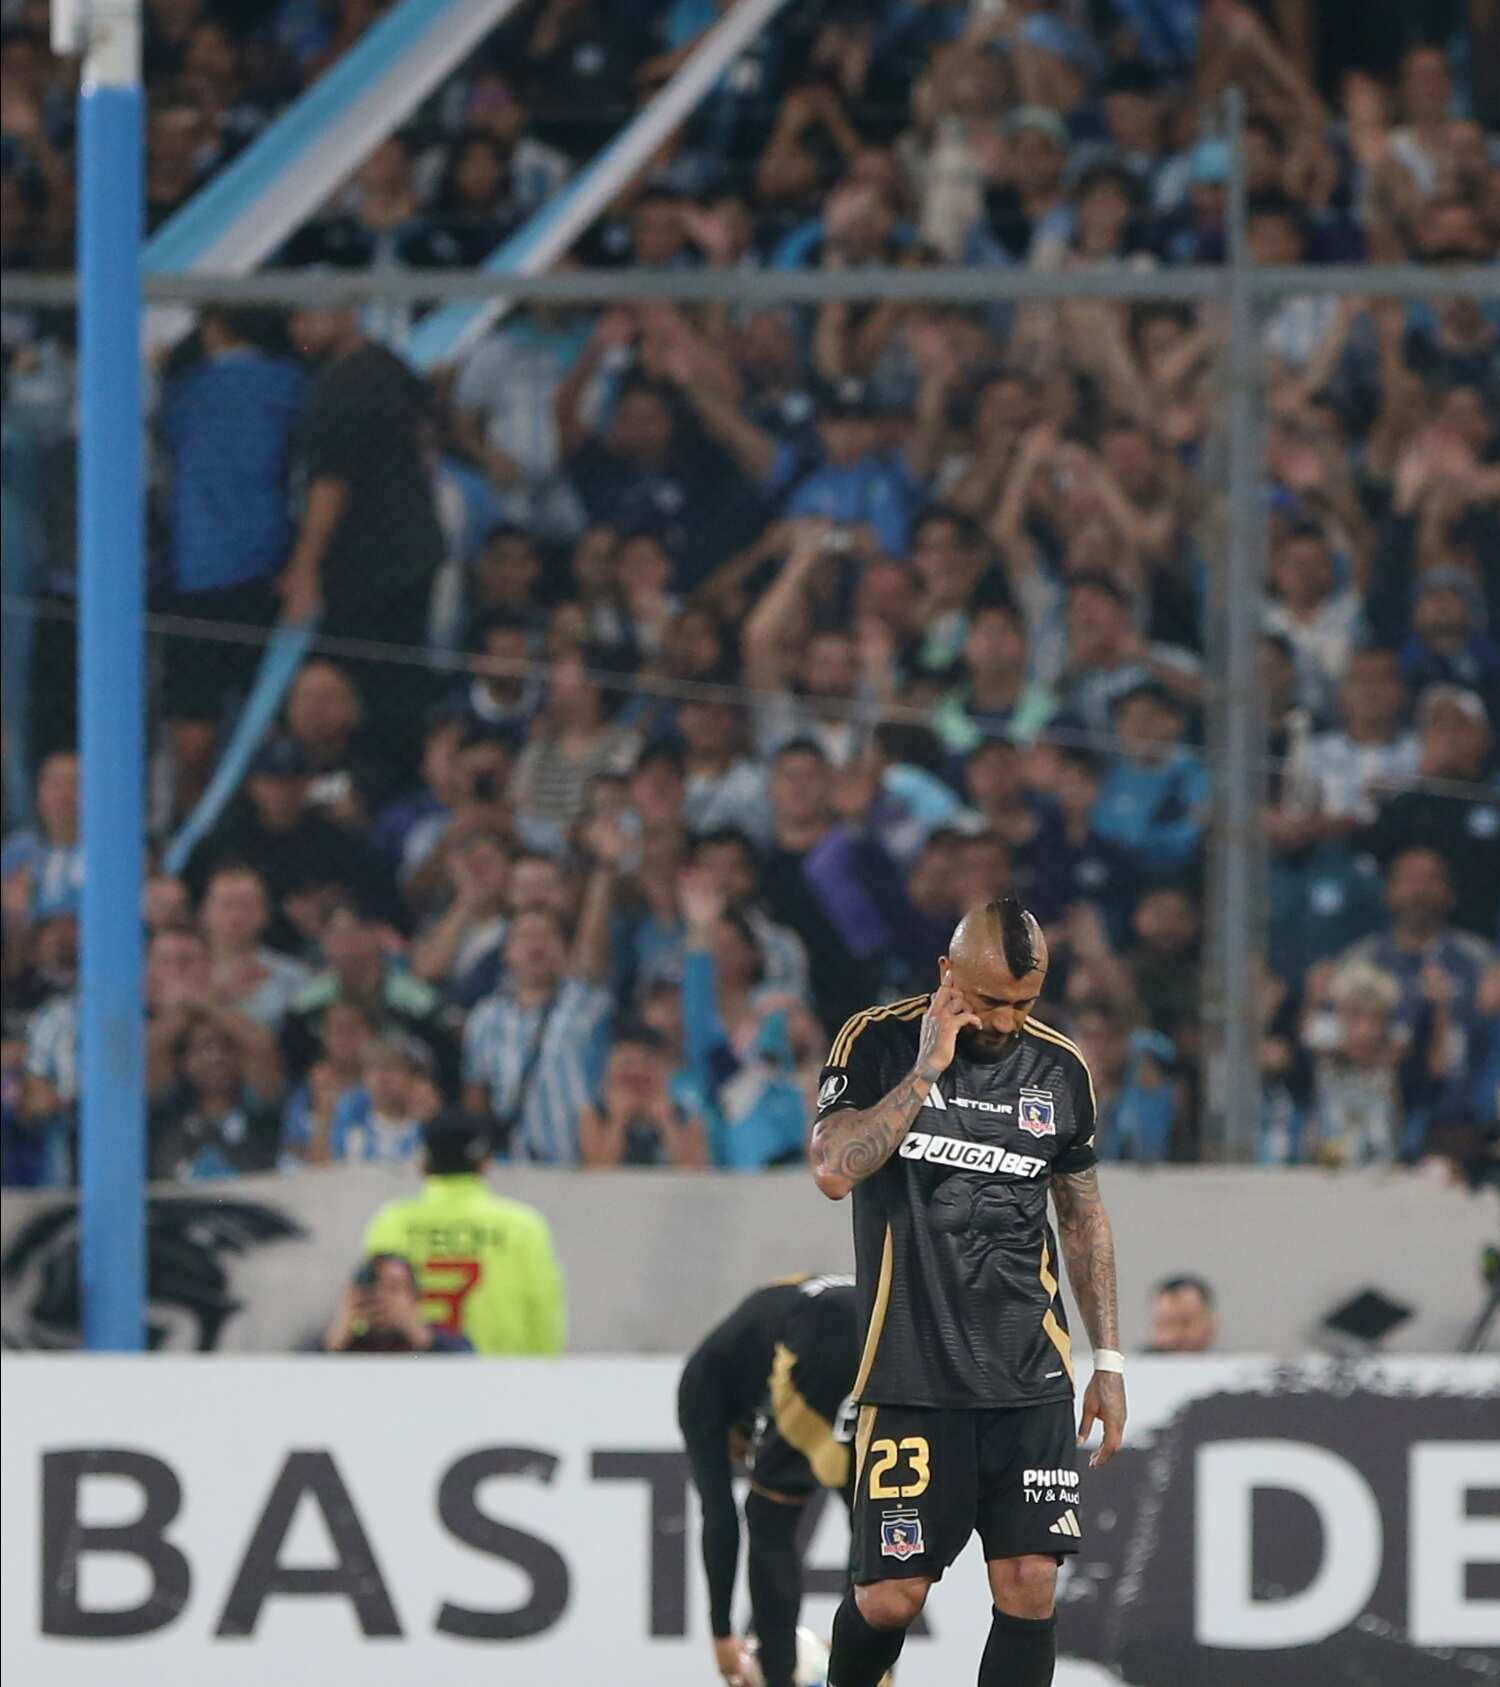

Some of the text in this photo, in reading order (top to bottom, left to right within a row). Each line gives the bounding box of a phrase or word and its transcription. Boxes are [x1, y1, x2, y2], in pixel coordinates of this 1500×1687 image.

[948, 1097, 1014, 1114] JETOUR
[869, 1435, 931, 1500] 23
[1023, 1488, 1043, 1503] TV
[1044, 1488, 1056, 1502] &
